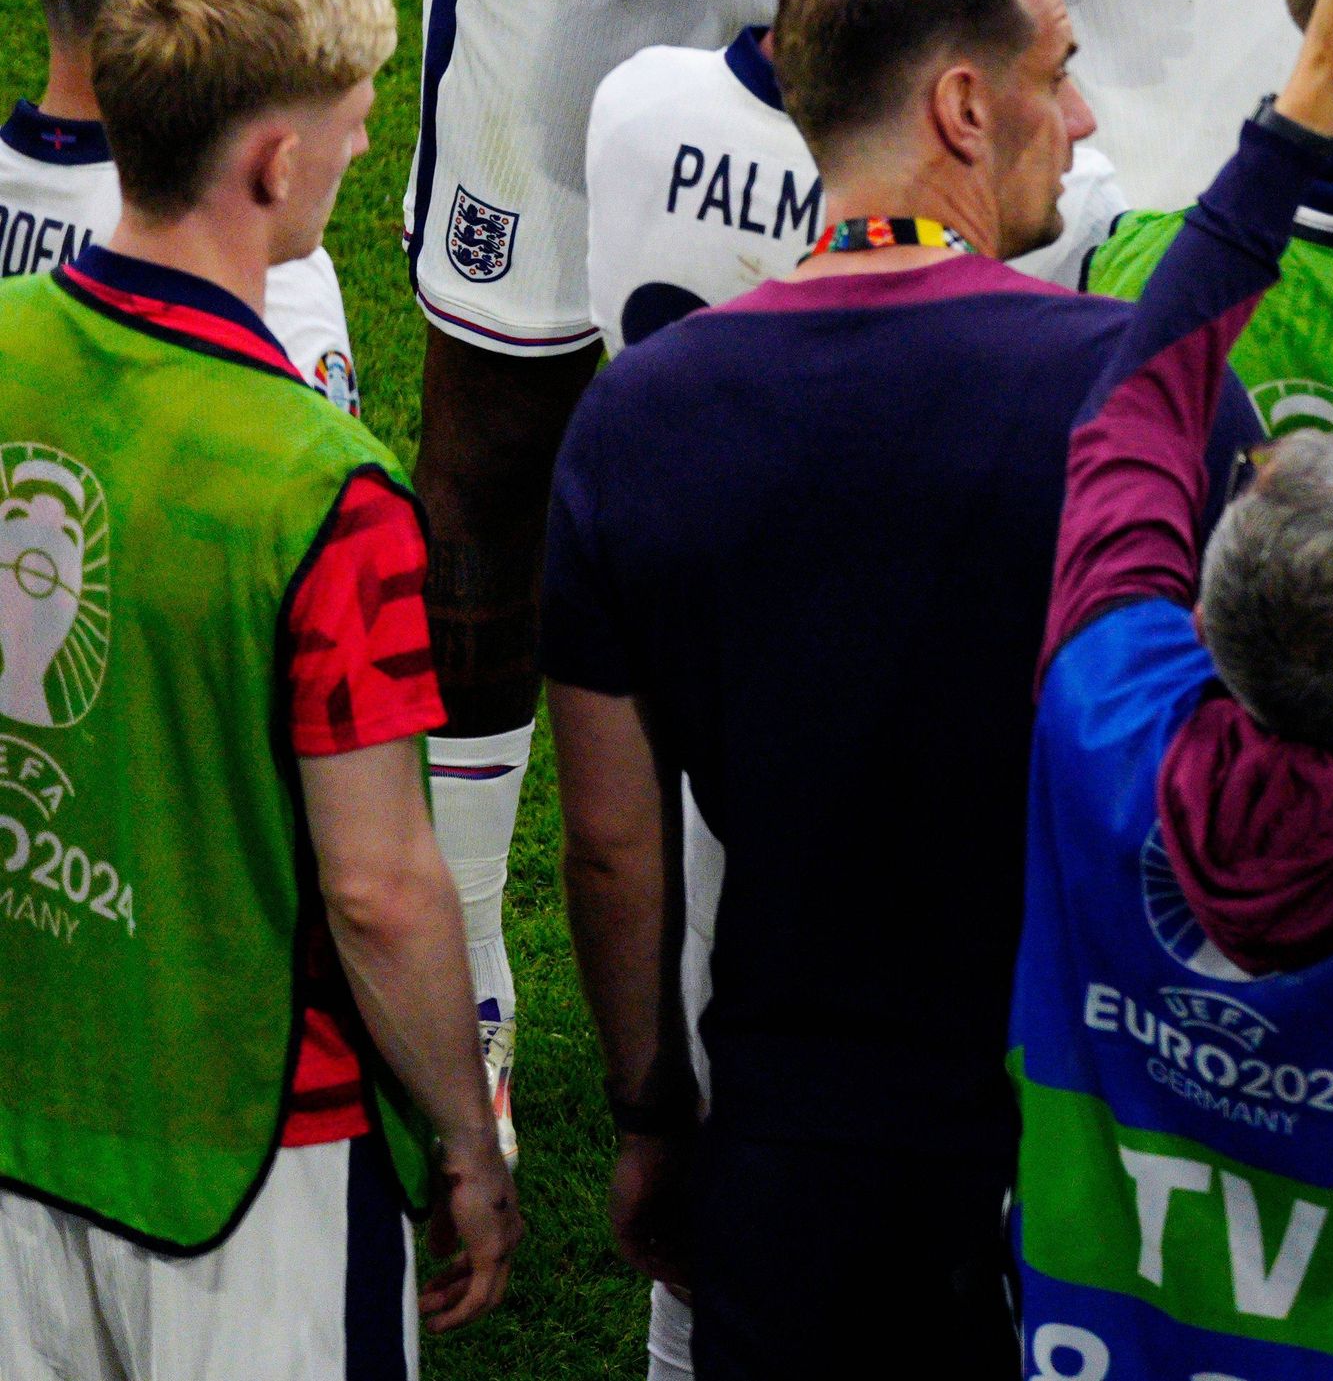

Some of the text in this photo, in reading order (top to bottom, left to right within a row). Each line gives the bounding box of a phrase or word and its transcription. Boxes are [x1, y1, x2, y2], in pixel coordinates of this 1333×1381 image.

[667, 143, 824, 246] PALM
[1164, 993, 1267, 1049] UEFA
[1147, 1056, 1298, 1136] GERMANY
[1119, 1142, 1329, 1321] TV
